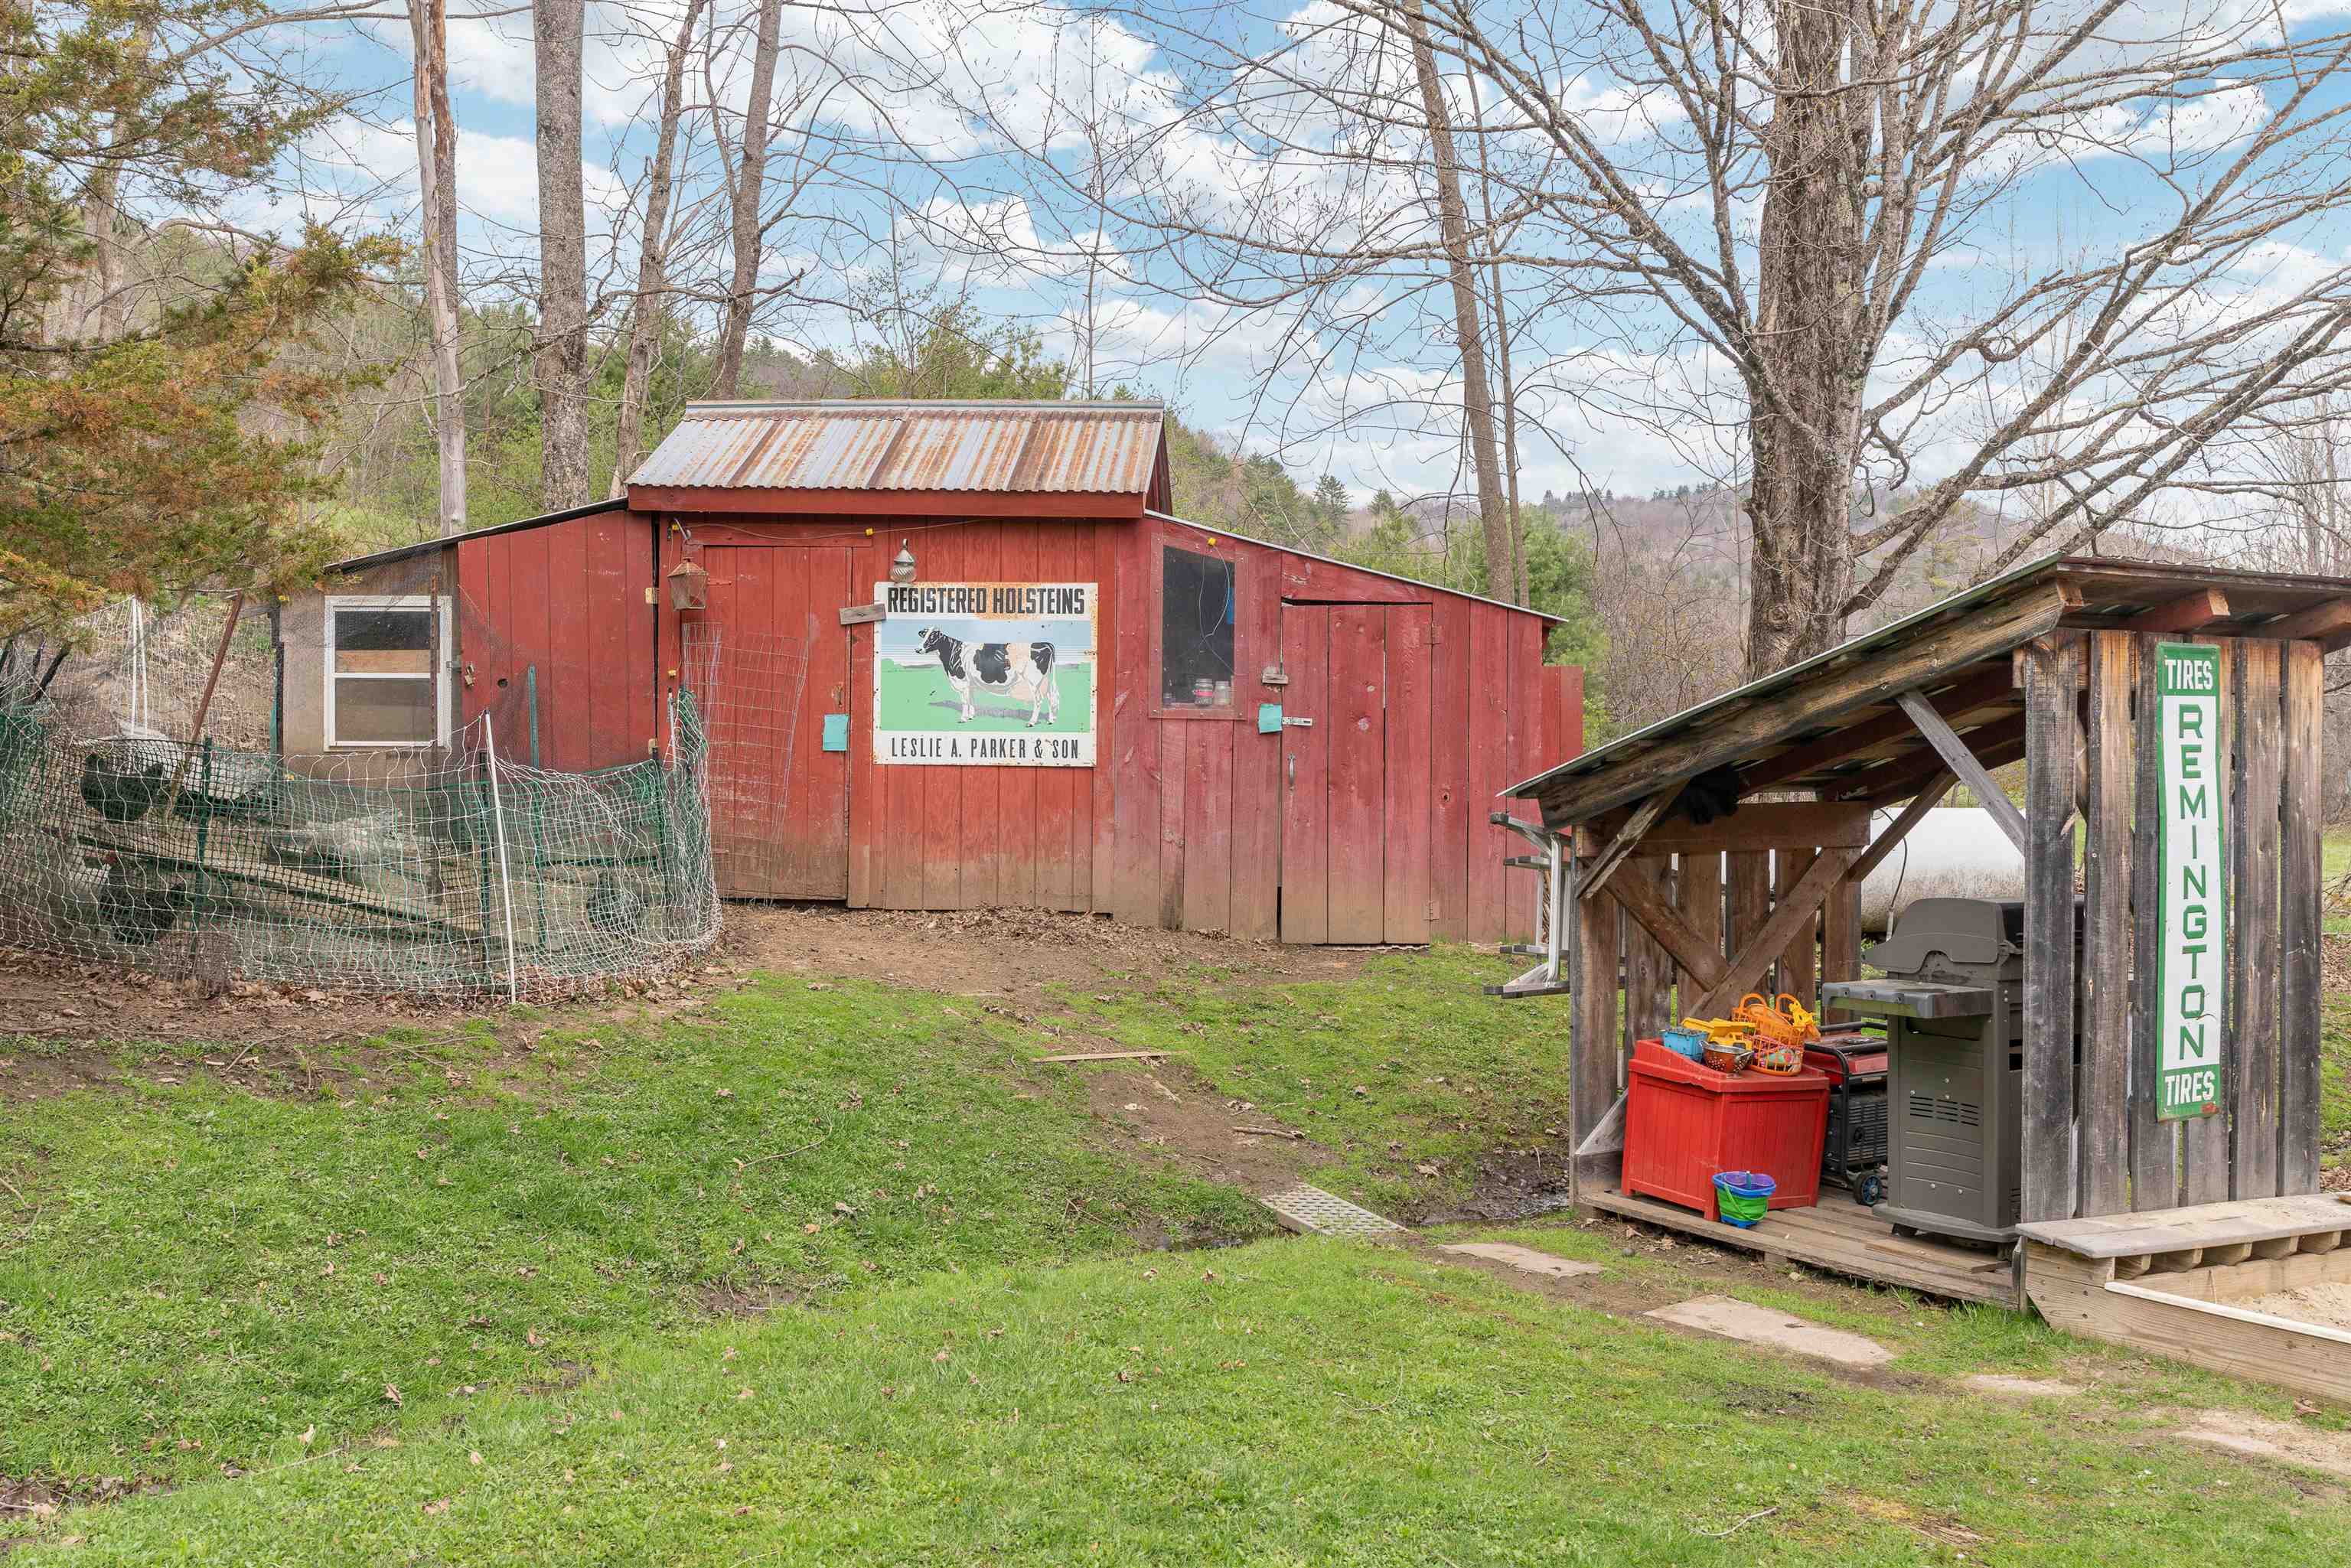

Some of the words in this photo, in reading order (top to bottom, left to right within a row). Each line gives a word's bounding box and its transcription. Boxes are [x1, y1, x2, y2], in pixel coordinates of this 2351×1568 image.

[888, 587, 986, 613] REGISTERED
[993, 588, 1084, 614] HOLSTEINS
[2164, 658, 2213, 690] TIRES
[892, 737, 942, 758] LESLIE
[951, 738, 962, 758] A.
[970, 738, 1026, 758] PARKER
[1035, 738, 1043, 758] &
[1052, 738, 1078, 758] SON
[2178, 703, 2207, 1060] REMINGTON
[2164, 1071, 2216, 1105] TIRES
